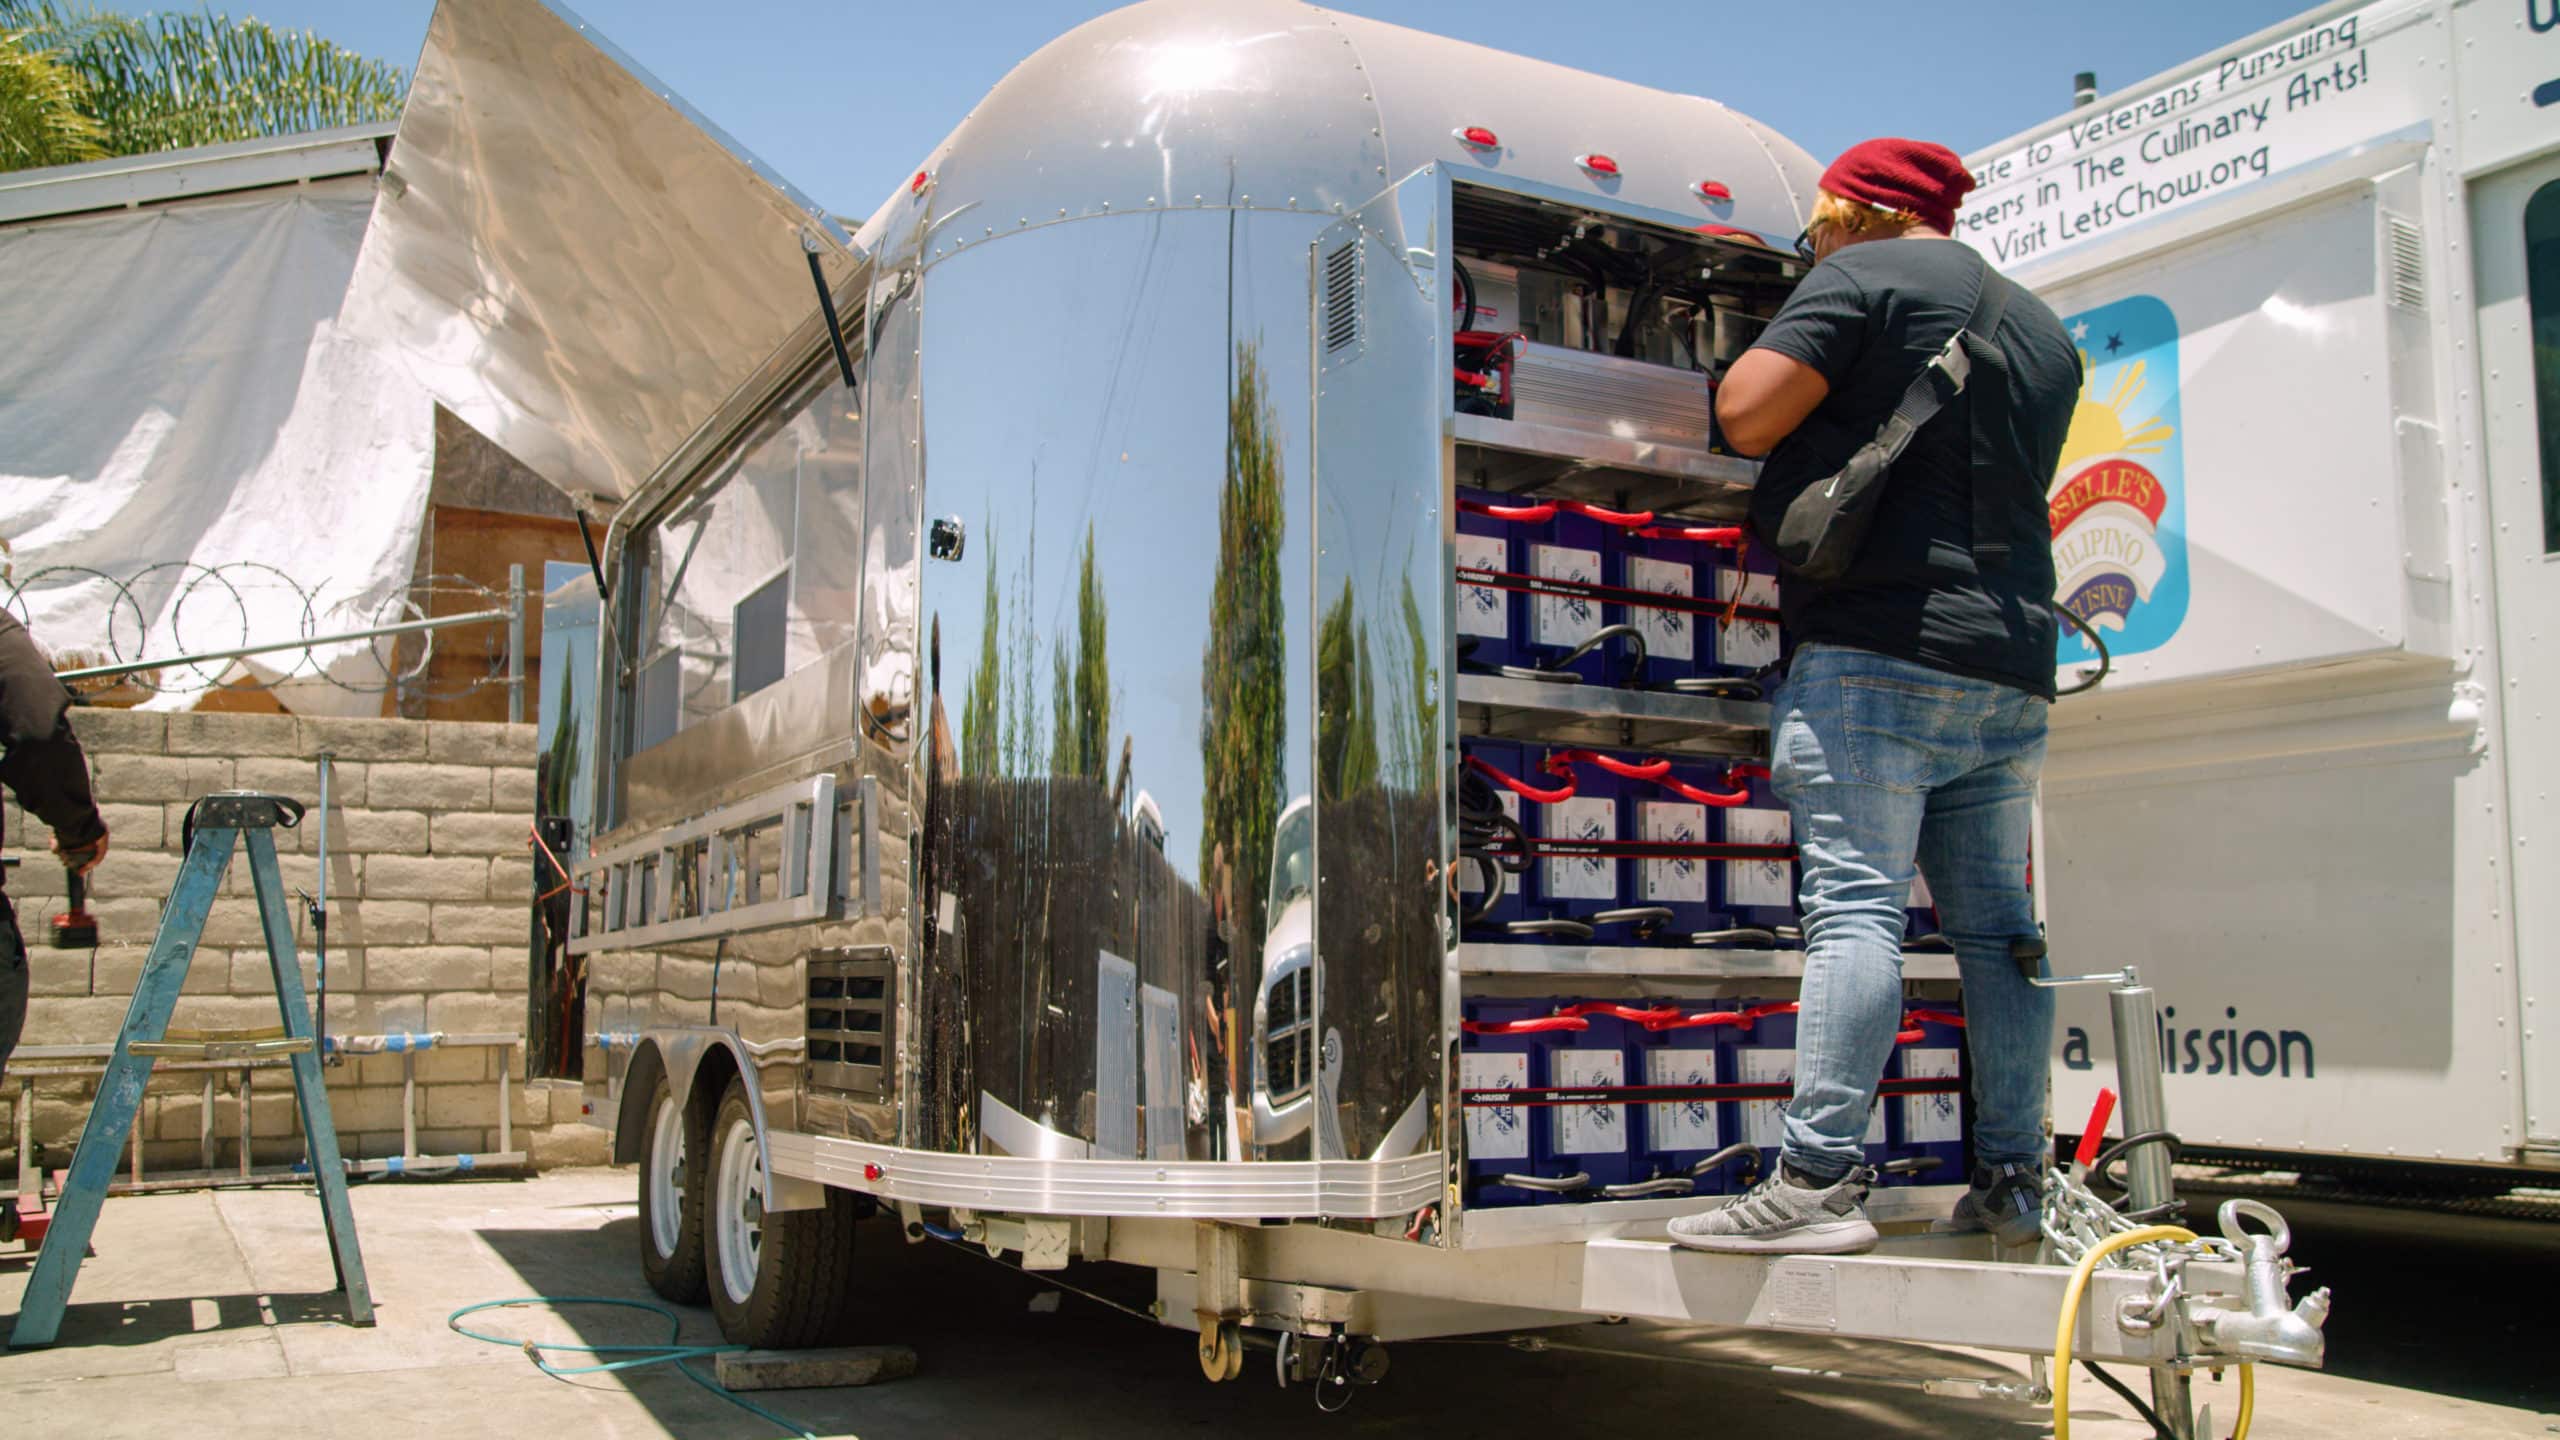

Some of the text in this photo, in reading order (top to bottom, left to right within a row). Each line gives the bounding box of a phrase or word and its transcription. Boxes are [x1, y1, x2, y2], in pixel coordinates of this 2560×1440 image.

[1955, 49, 2368, 238] reers in The Culinary Arts!
[1975, 15, 2359, 189] ate to Veterans Pursuing
[1992, 145, 2270, 263] Visit LetsChow.org
[2050, 467, 2155, 528] OSELLE'S
[2062, 1005, 2315, 1079] a ission
